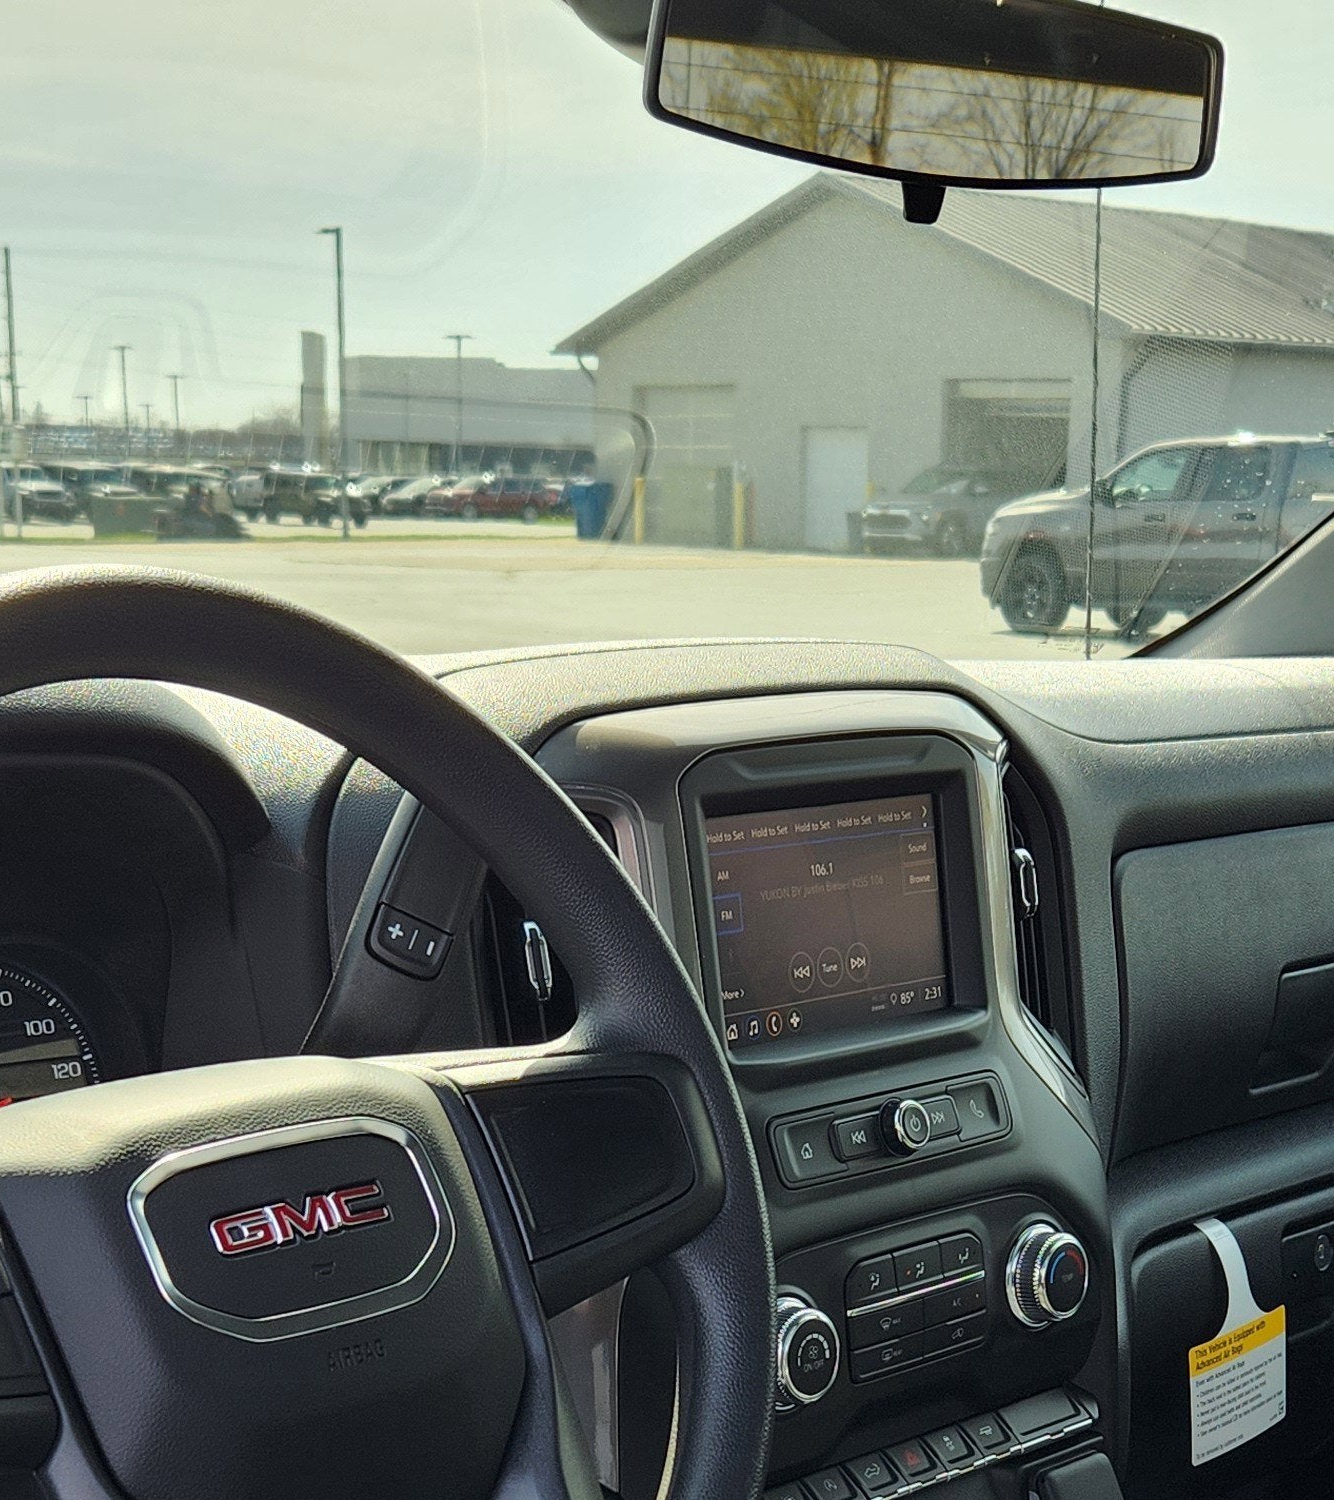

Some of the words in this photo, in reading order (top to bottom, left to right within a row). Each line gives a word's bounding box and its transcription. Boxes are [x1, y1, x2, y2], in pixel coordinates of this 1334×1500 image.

[908, 843, 927, 854] Sound
[717, 870, 729, 881] AM
[810, 862, 833, 877] 106.1
[909, 873, 931, 884] Browse
[721, 910, 733, 921] FM
[821, 962, 838, 973] Tune
[721, 988, 739, 1000] More
[925, 986, 942, 1000] 2:31
[24, 1019, 55, 1036] 100
[51, 1061, 82, 1079] 120
[208, 1179, 391, 1258] GMC
